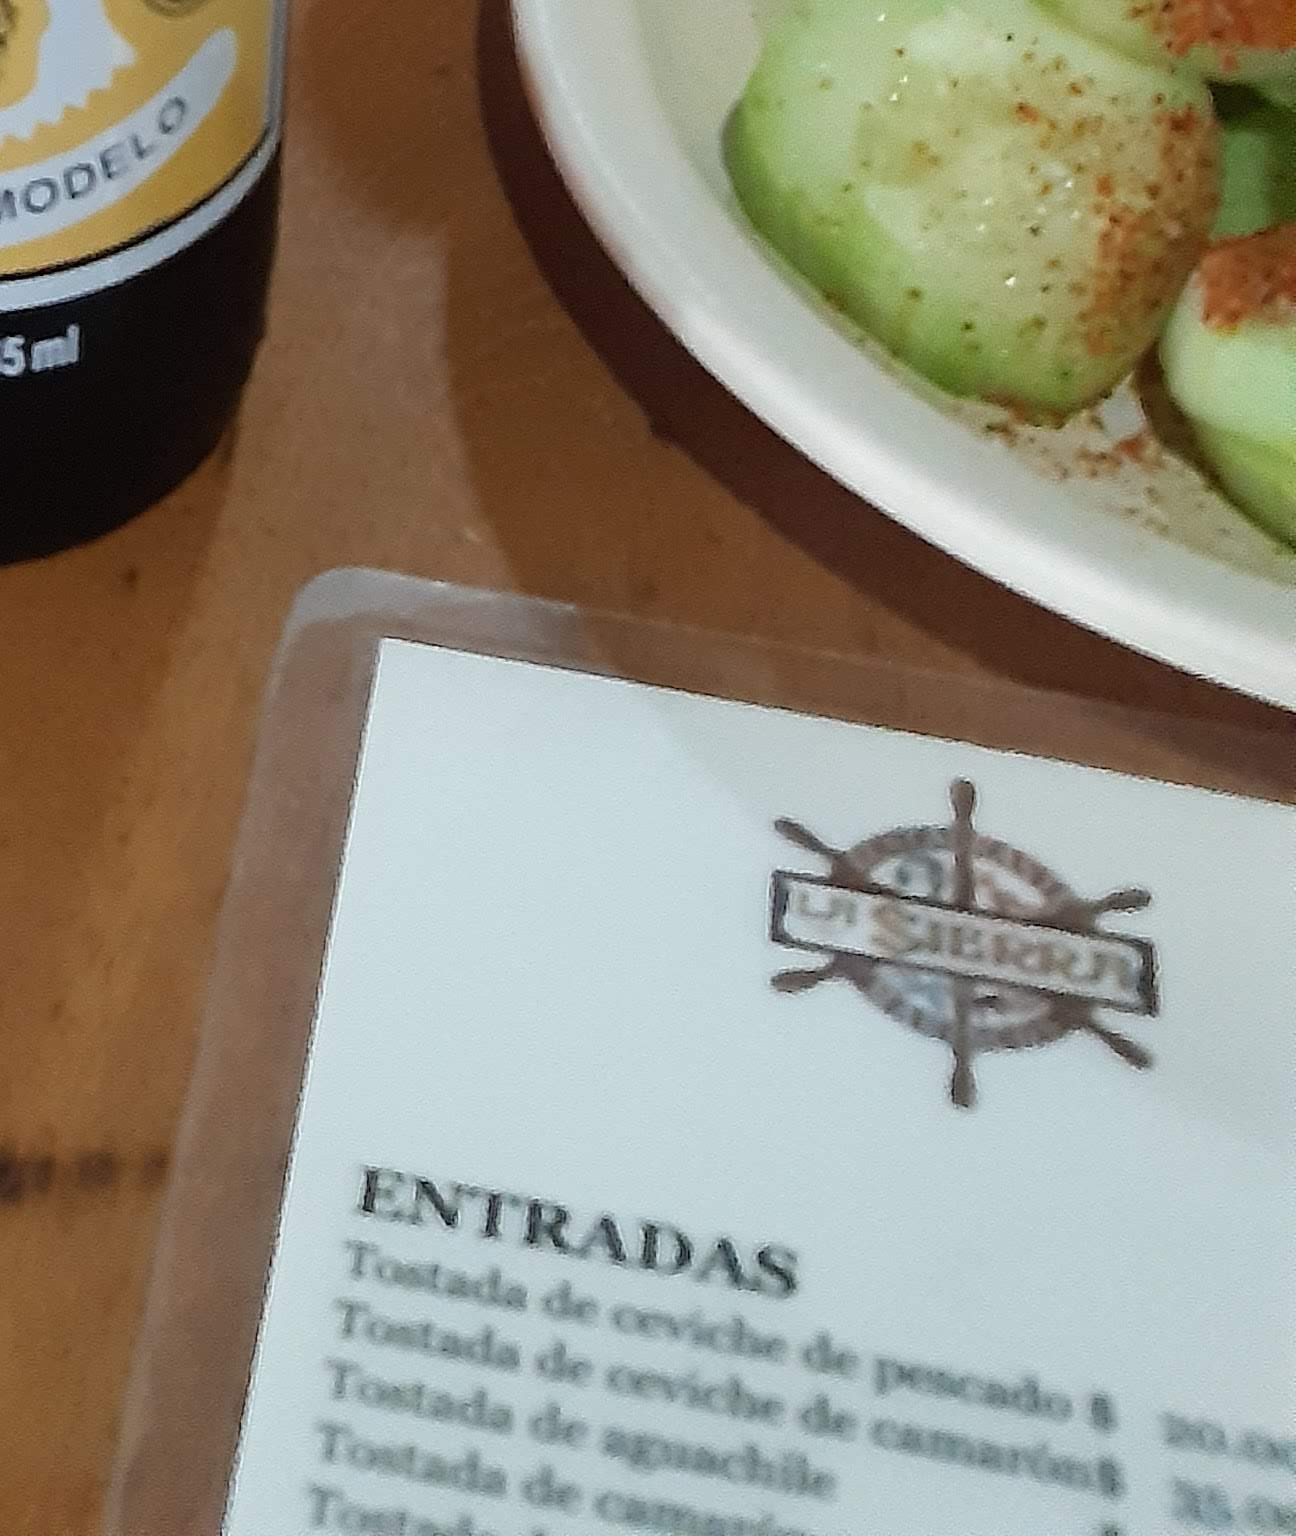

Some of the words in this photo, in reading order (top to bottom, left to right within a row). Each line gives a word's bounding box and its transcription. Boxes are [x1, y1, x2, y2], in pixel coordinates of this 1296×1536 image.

[30, 324, 80, 374] ml
[355, 1164, 800, 1301] ENTRADAS
[335, 1299, 521, 1372] Tostada
[534, 1340, 594, 1387] de
[604, 1366, 785, 1425] ceviche
[797, 1393, 858, 1441] de
[344, 1239, 528, 1312] Tostada
[540, 1280, 599, 1326] de
[609, 1305, 788, 1362] ceviche
[800, 1332, 860, 1380] de
[872, 1356, 1073, 1422] pescado
[317, 1421, 507, 1498] Tostada
[520, 1465, 582, 1515] de
[592, 1491, 816, 1536] camar
[326, 1359, 514, 1435] Tostada
[527, 1401, 590, 1448] de
[599, 1426, 836, 1500] aguachile
[309, 1484, 510, 1536] Tostad
